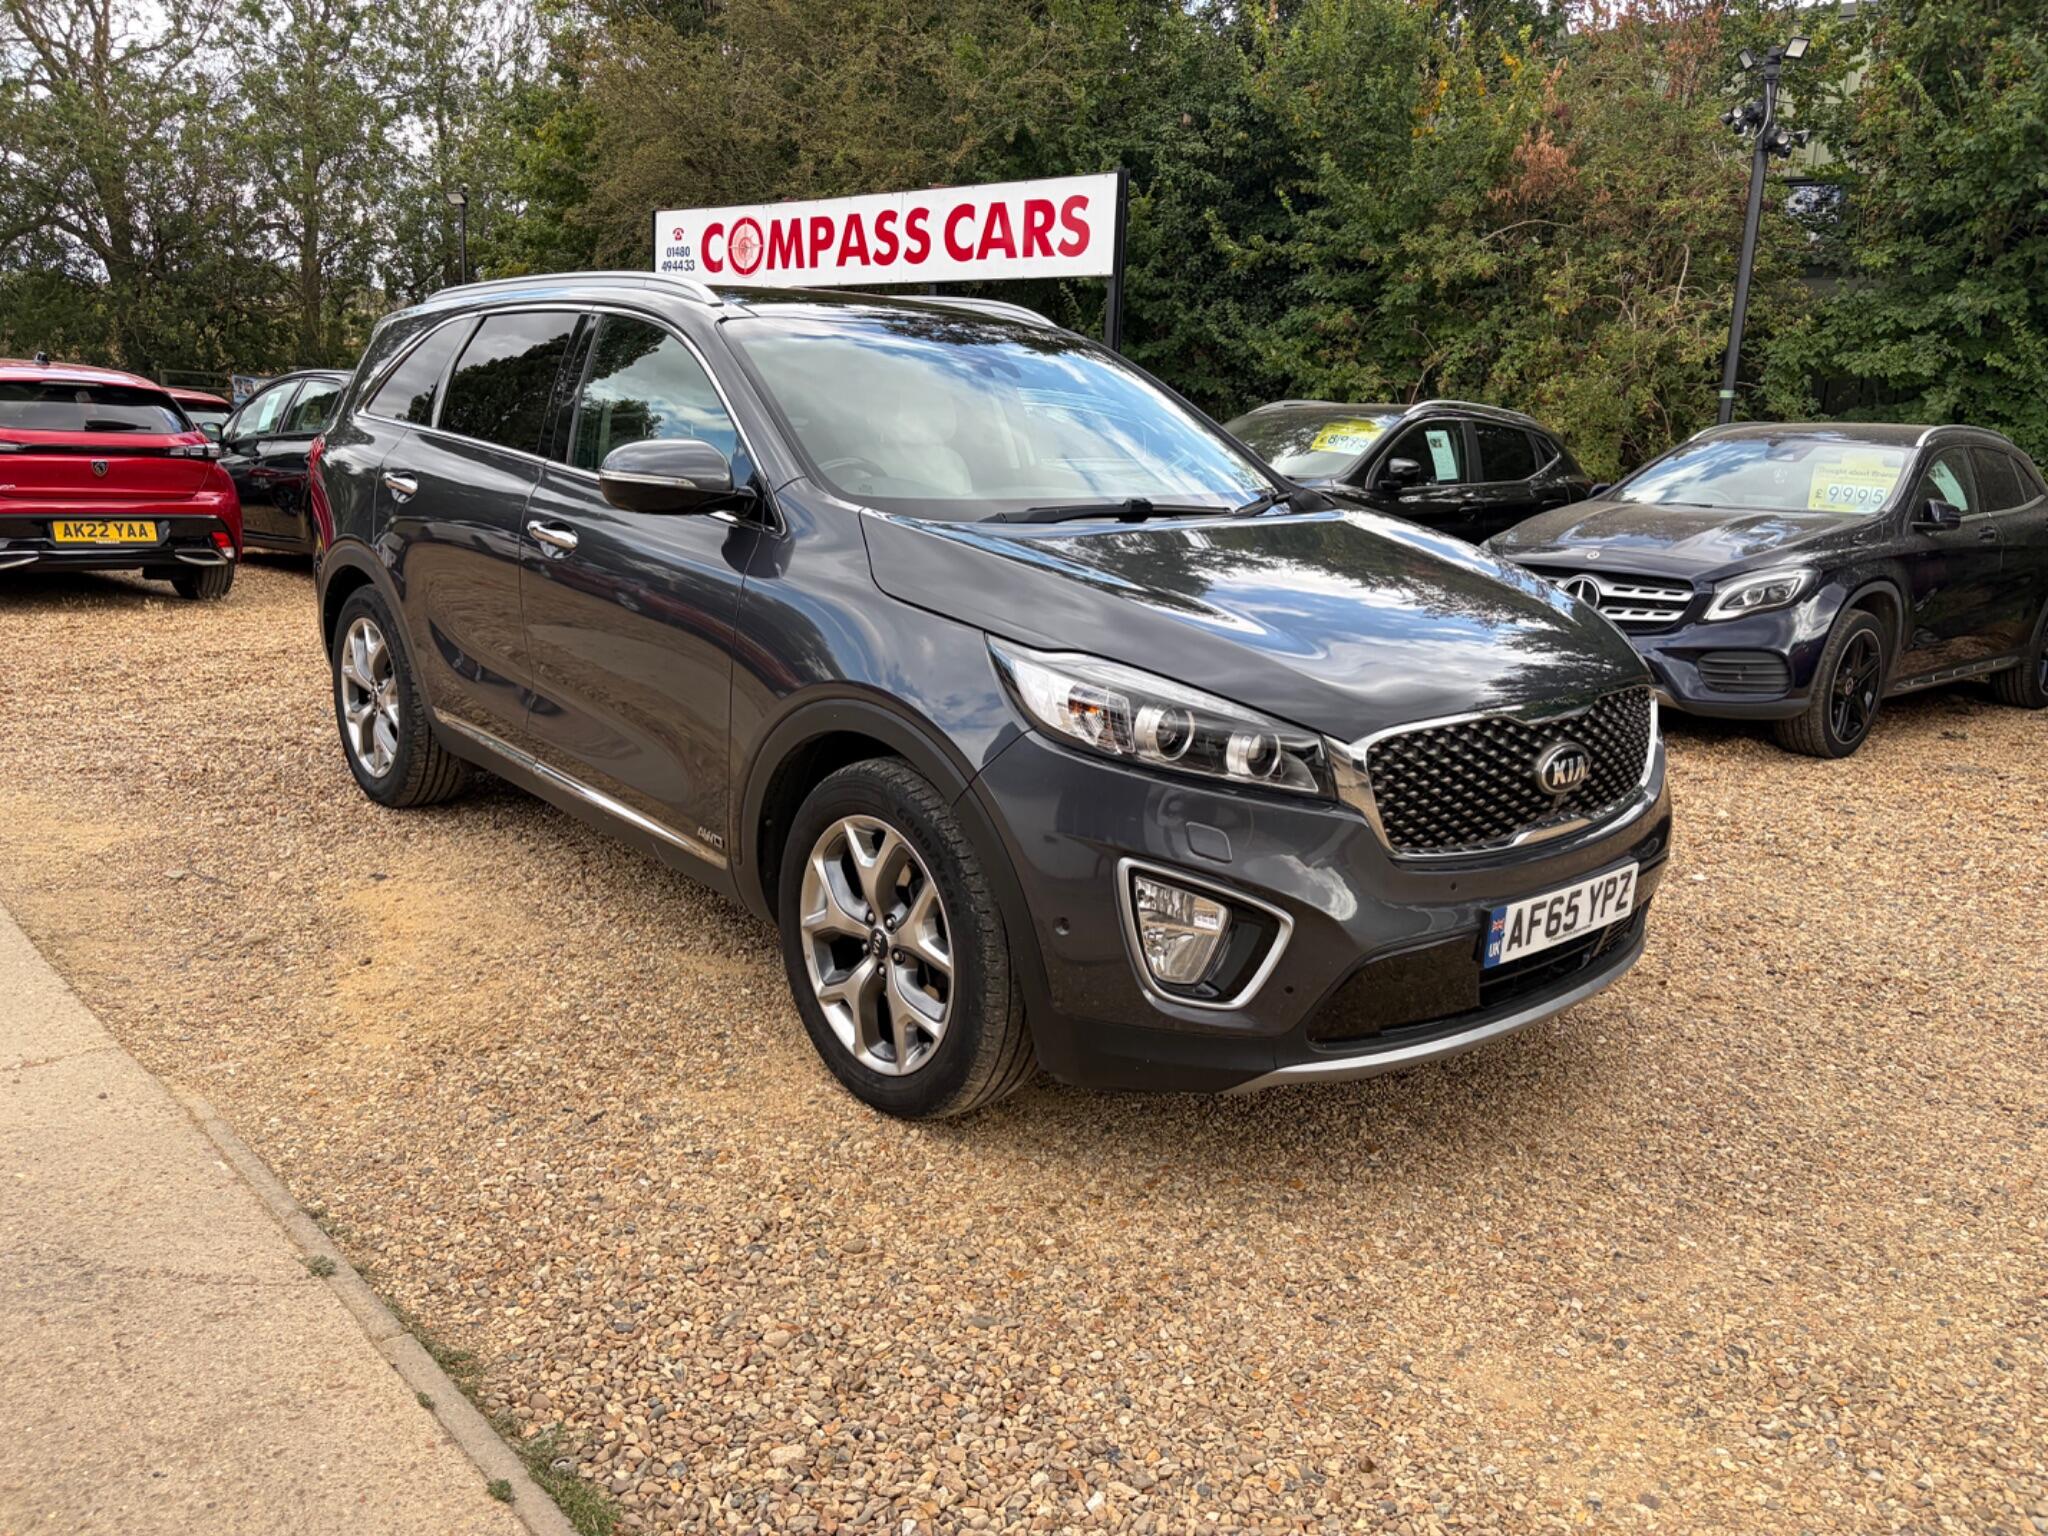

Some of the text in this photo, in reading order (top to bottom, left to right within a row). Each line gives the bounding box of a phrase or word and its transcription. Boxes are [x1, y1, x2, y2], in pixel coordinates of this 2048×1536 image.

[701, 194, 1091, 277] COMPASS CARS
[666, 246, 691, 258] 01480
[661, 259, 695, 272] 494433
[63, 523, 149, 538] AK22 YAA
[1552, 755, 1587, 786] KIA
[1506, 870, 1633, 952] AF65 YPZ
[1488, 941, 1500, 957] UK
